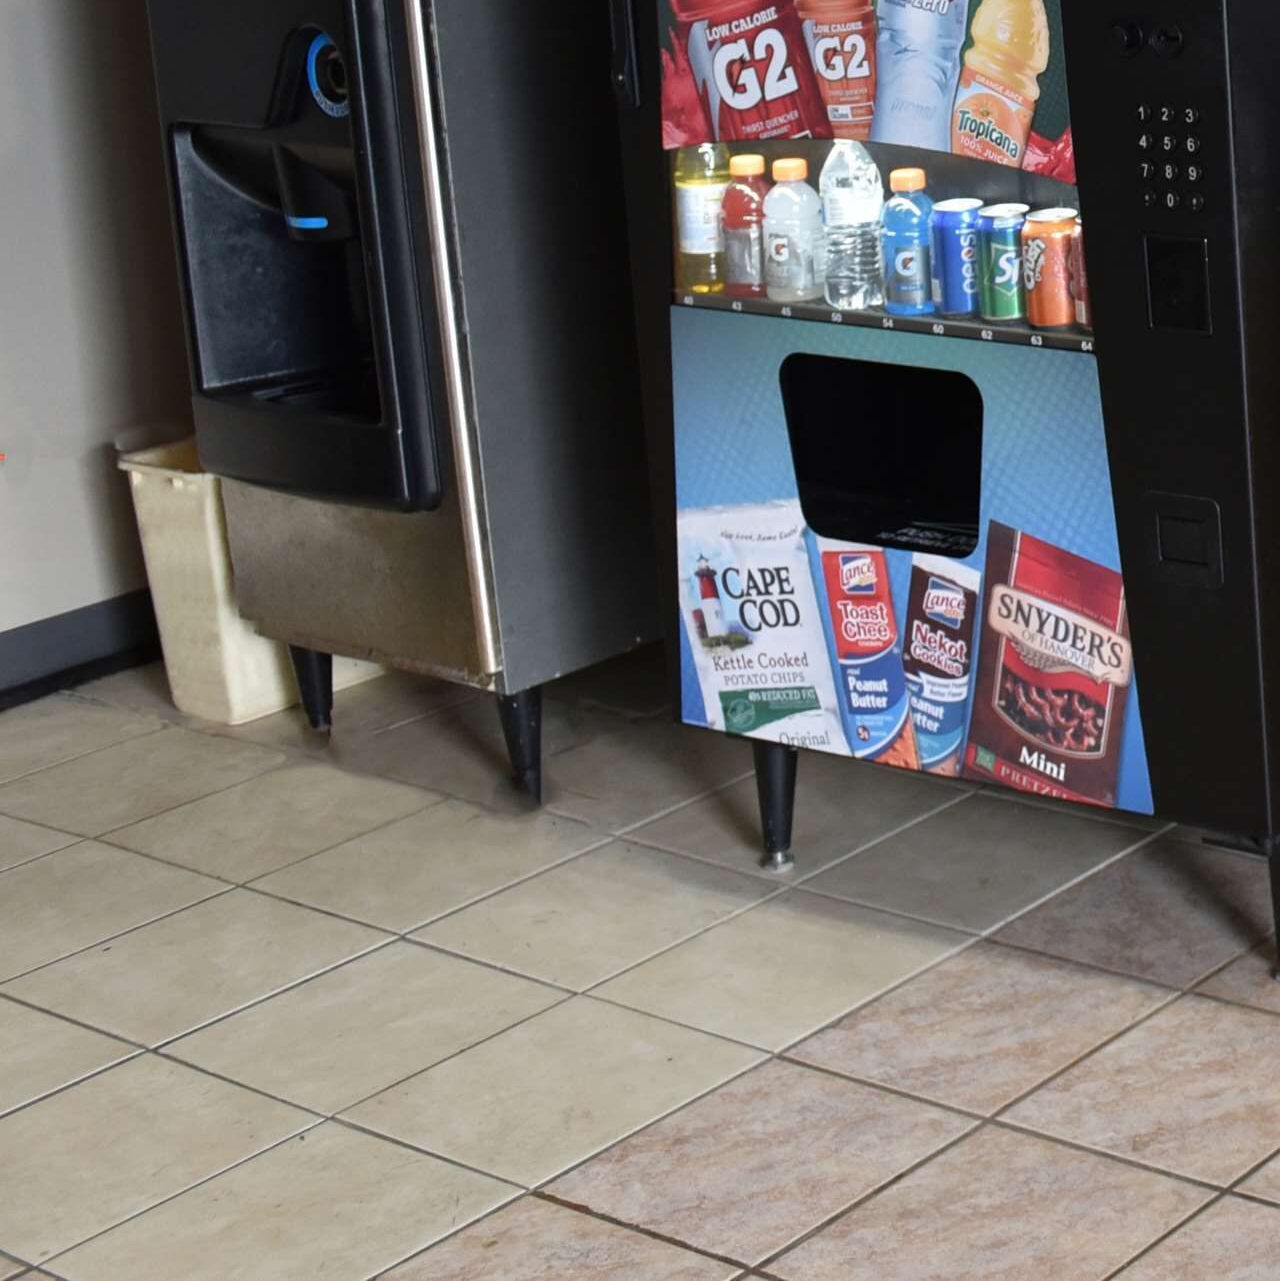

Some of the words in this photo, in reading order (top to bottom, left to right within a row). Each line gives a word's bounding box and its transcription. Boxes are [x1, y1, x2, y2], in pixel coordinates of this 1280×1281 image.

[705, 24, 729, 41] LOW
[731, 6, 778, 34] CALORIE
[815, 34, 870, 80] G2
[713, 28, 798, 110] G2
[1138, 106, 1145, 120] 1
[1161, 108, 1169, 121] 2
[1185, 109, 1193, 123] 3
[958, 109, 1019, 158] Tropicana
[1139, 135, 1147, 148] 4
[1163, 136, 1171, 150] 5
[1187, 138, 1195, 151] 6
[1141, 164, 1148, 177] 7
[1165, 165, 1173, 179] 8
[1188, 166, 1197, 180] 9
[1166, 193, 1174, 207] 0
[770, 237, 789, 262] G
[895, 251, 917, 277] G
[883, 318, 893, 328] 54
[933, 324, 944, 334] 60
[981, 330, 992, 340] 62
[1031, 335, 1042, 345] 63
[1081, 341, 1092, 350] 64
[722, 566, 794, 600] CAPE
[840, 560, 875, 588] Lance
[838, 602, 886, 621] Toast
[924, 591, 966, 615] Lance
[739, 598, 800, 632] COD
[842, 619, 890, 642] Chee
[913, 621, 967, 661] Nekot
[998, 593, 1123, 668] SNYDER'S
[911, 642, 963, 676] Cookies
[1022, 629, 1038, 642] OF
[1040, 638, 1095, 670] HANOVER
[713, 654, 754, 671] Kettle
[757, 652, 809, 669] Cooked
[723, 673, 768, 686] POTATO
[771, 671, 806, 684] CHIPS
[848, 677, 888, 693] Peanut
[762, 689, 800, 701] REDUCED
[851, 694, 889, 709] Butter
[779, 731, 831, 749] Original
[1019, 746, 1066, 782] Mini
